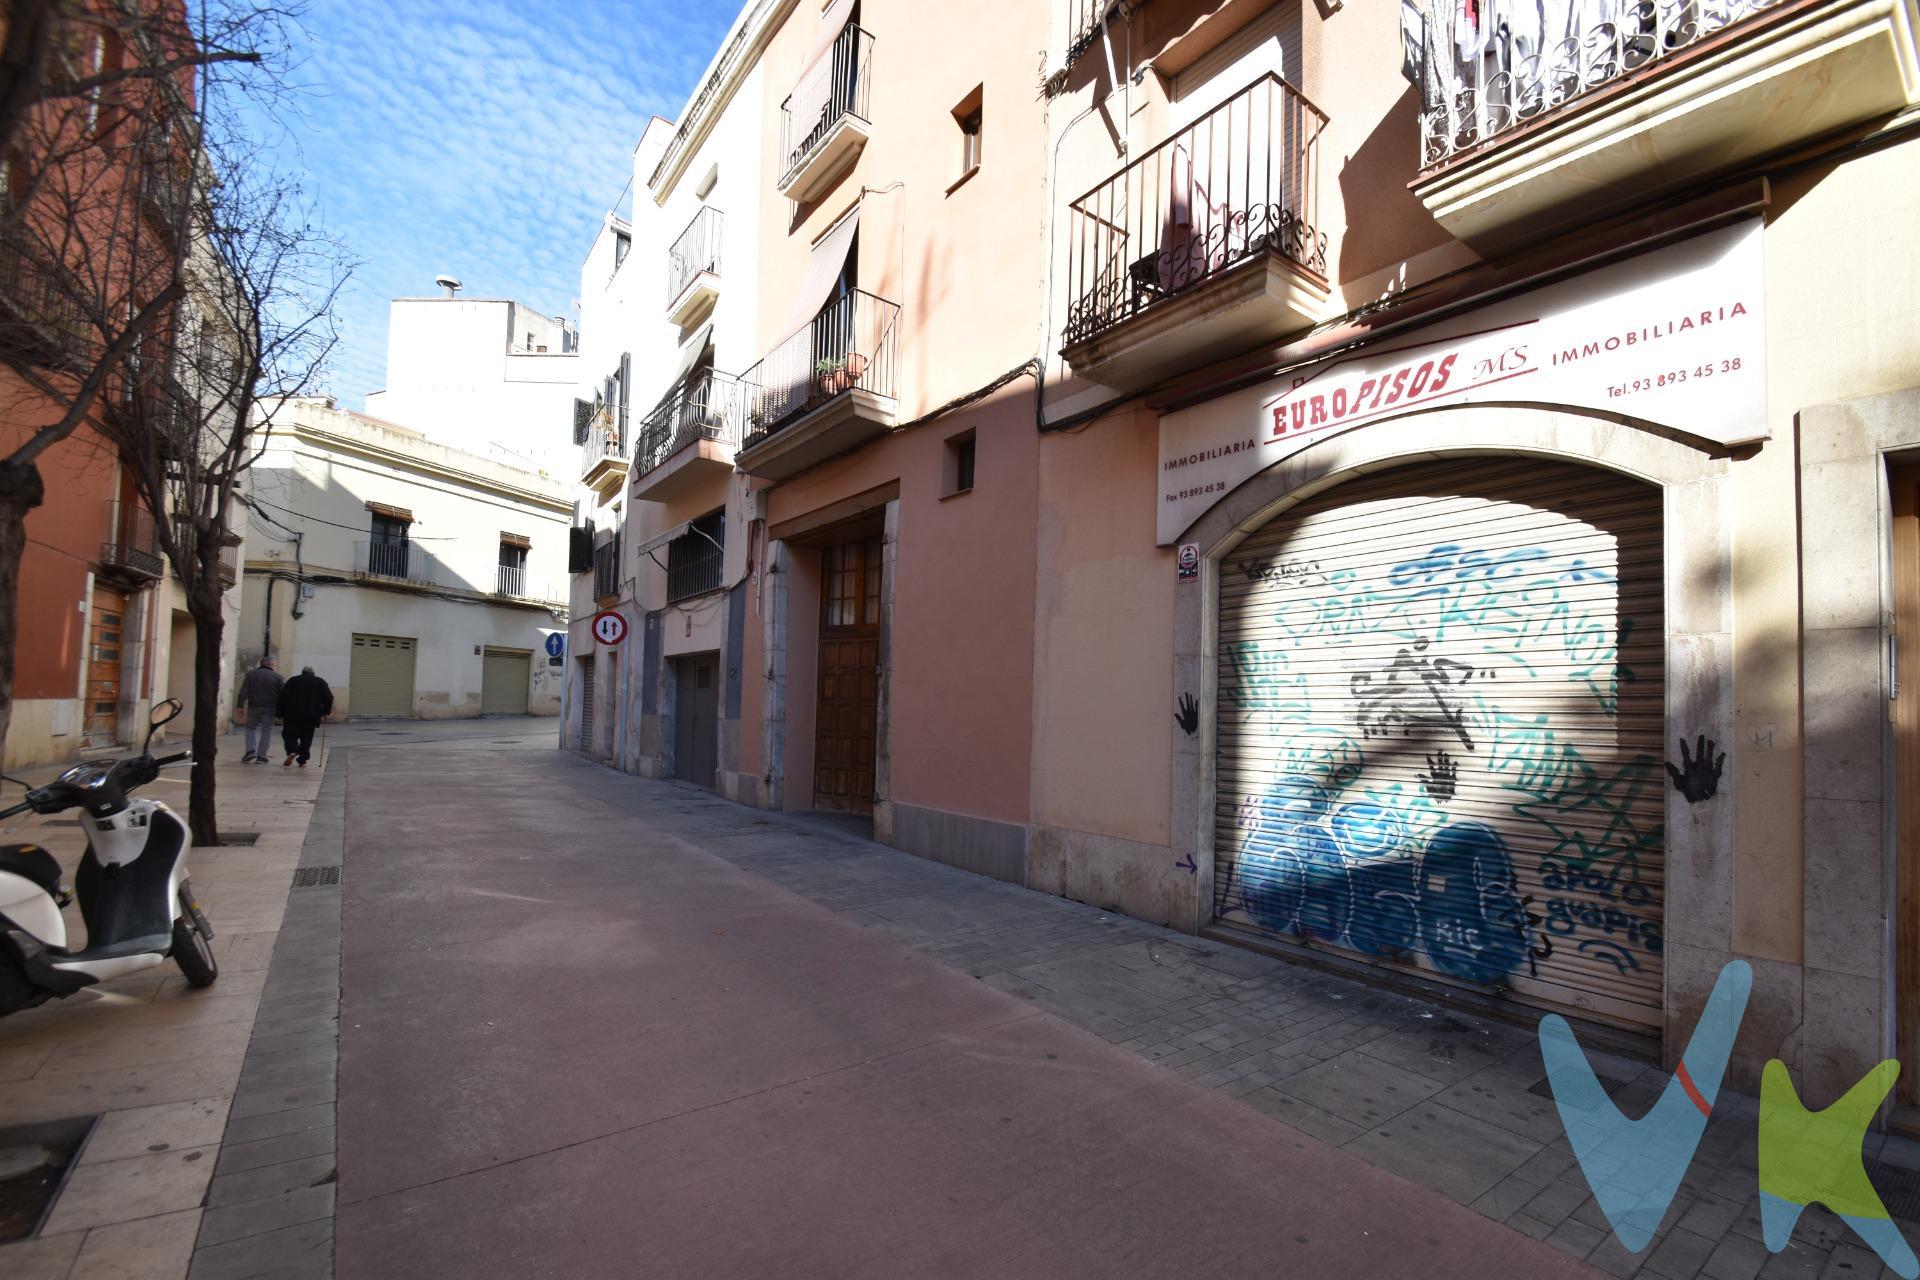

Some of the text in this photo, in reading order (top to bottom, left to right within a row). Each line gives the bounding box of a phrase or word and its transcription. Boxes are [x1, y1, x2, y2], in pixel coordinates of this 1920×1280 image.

[1552, 302, 1747, 366] IMMOBILIARIA
[1657, 370, 1687, 387] 893
[1694, 363, 1714, 379] 45
[1721, 357, 1742, 373] 38
[1272, 344, 1528, 436] EUROPISOS MS
[1164, 439, 1256, 471] IMMOBILIARIA
[1166, 481, 1226, 503] Fax 93 893 45 38
